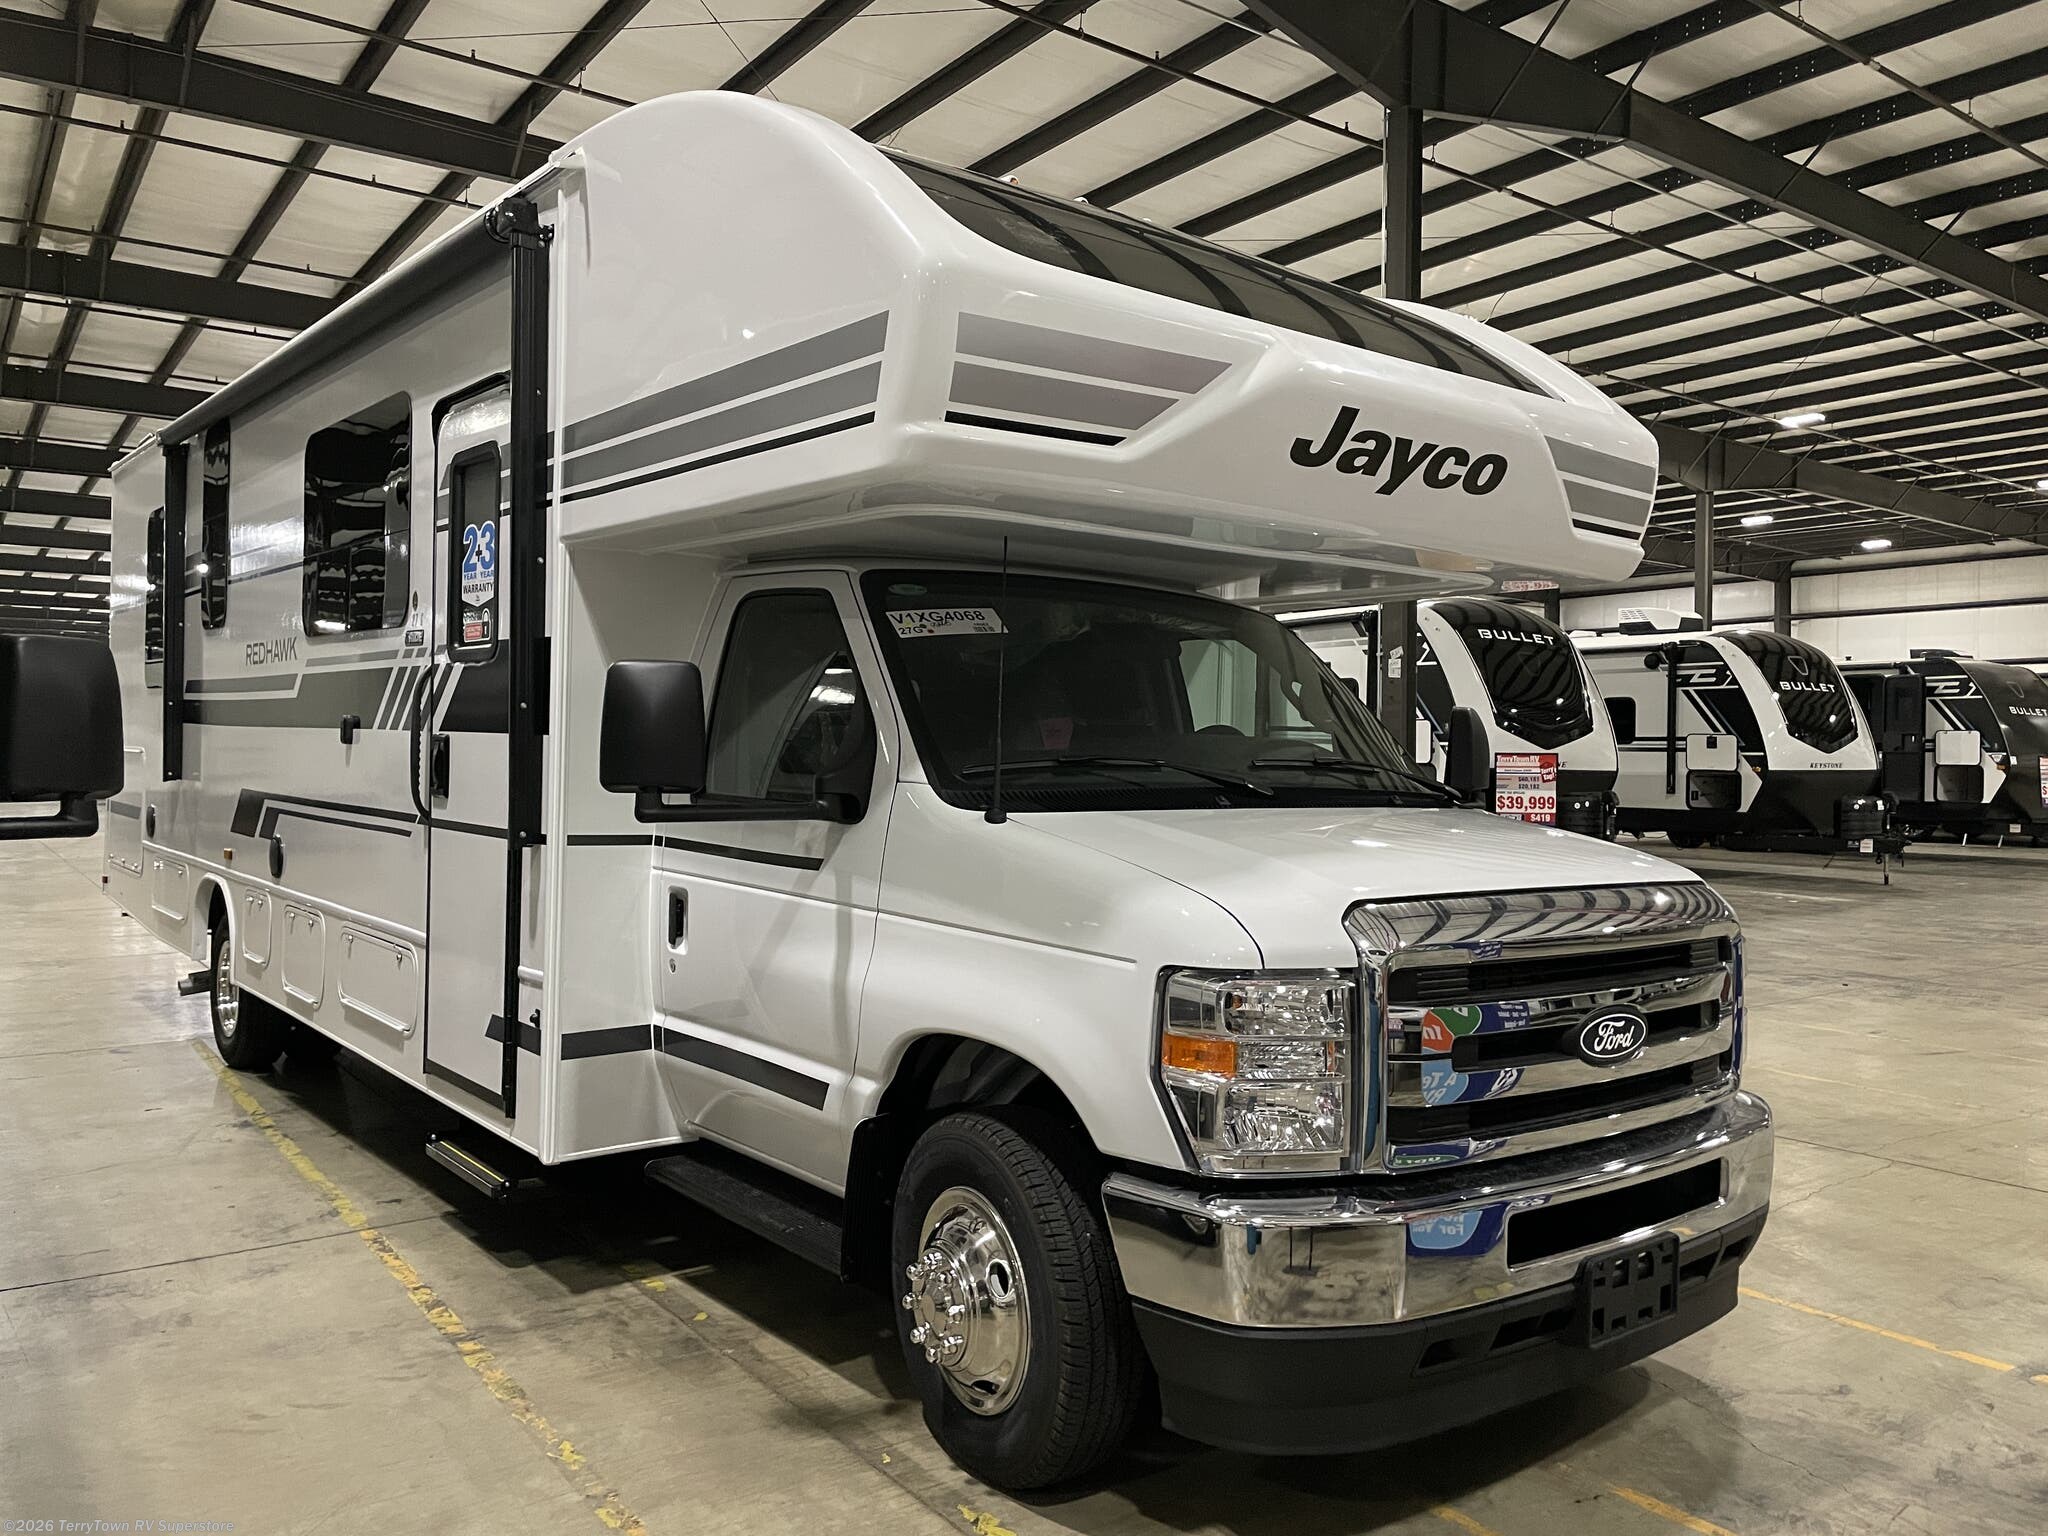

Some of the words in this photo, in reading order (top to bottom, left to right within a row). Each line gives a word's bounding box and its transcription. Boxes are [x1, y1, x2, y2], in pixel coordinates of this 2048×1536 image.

[1290, 405, 1508, 496] Jayco
[463, 571, 477, 581] YEAR
[480, 569, 494, 579] YEAR
[463, 582, 494, 594] WARRANTY
[1477, 628, 1554, 646] BULLET
[245, 636, 298, 667] REDHAWK
[1779, 681, 1836, 693] BULLET
[2009, 706, 2048, 717] BULLET
[1497, 795, 1555, 811] $39,999
[1594, 1020, 1635, 1052] Ford
